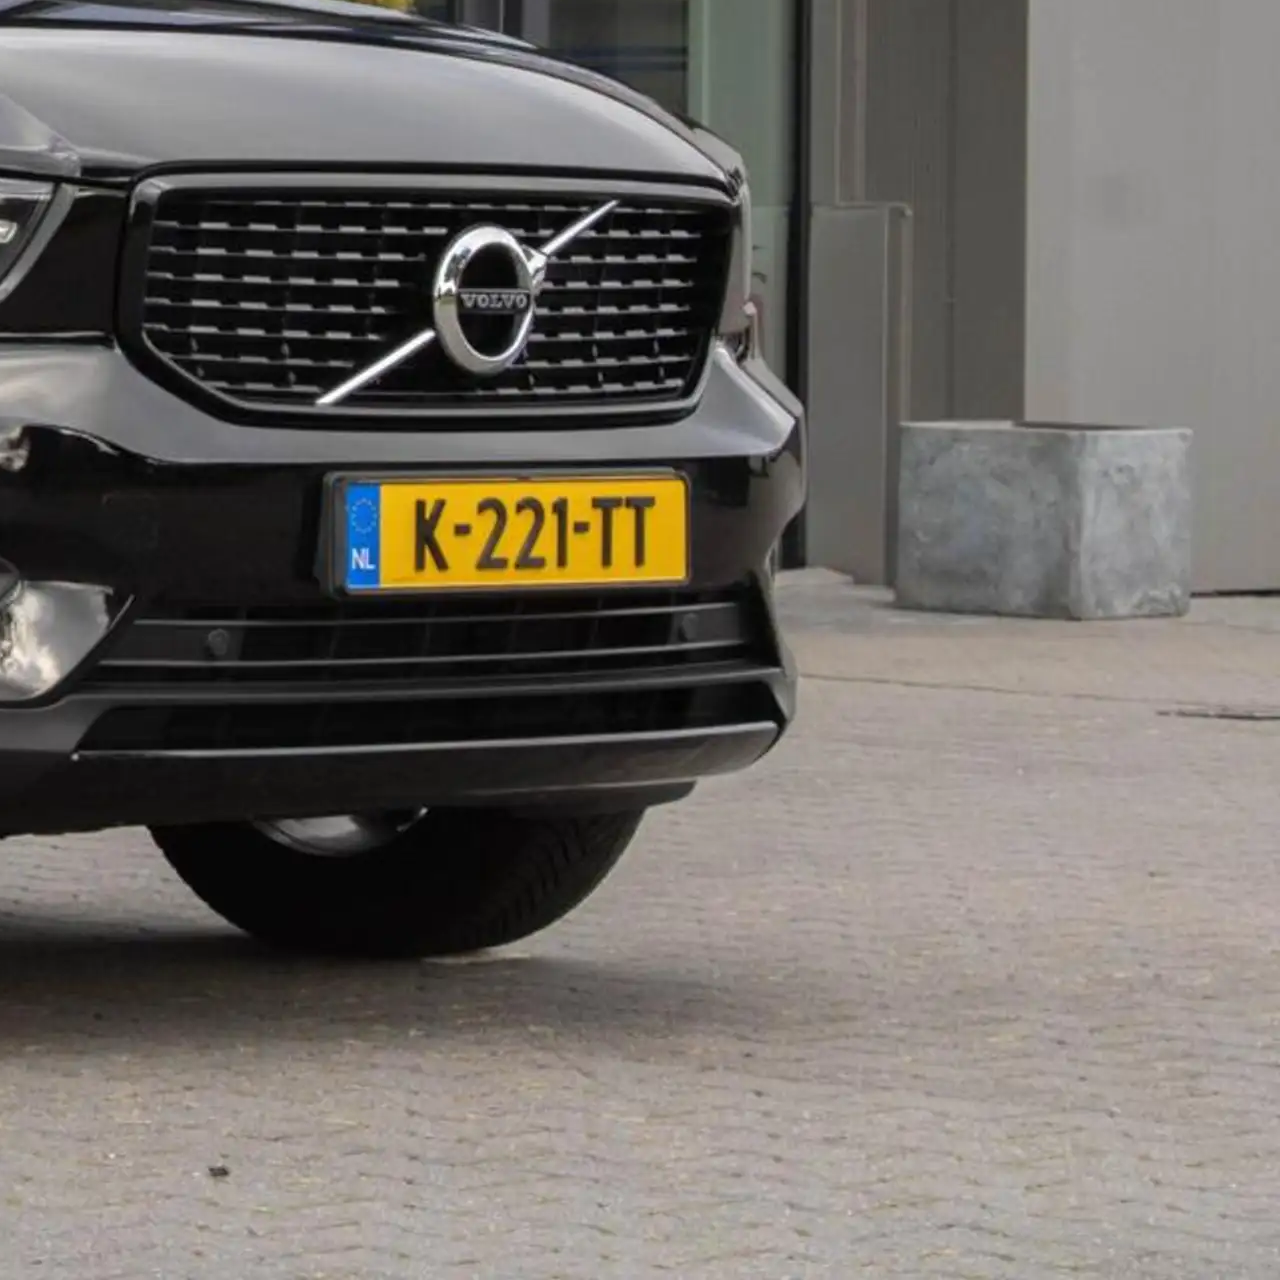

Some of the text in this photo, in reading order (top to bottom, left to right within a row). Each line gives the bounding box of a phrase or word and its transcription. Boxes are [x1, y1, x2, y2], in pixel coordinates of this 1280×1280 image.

[460, 292, 528, 309] VOLVO
[413, 496, 656, 573] K-221-TT
[351, 547, 376, 570] NL
